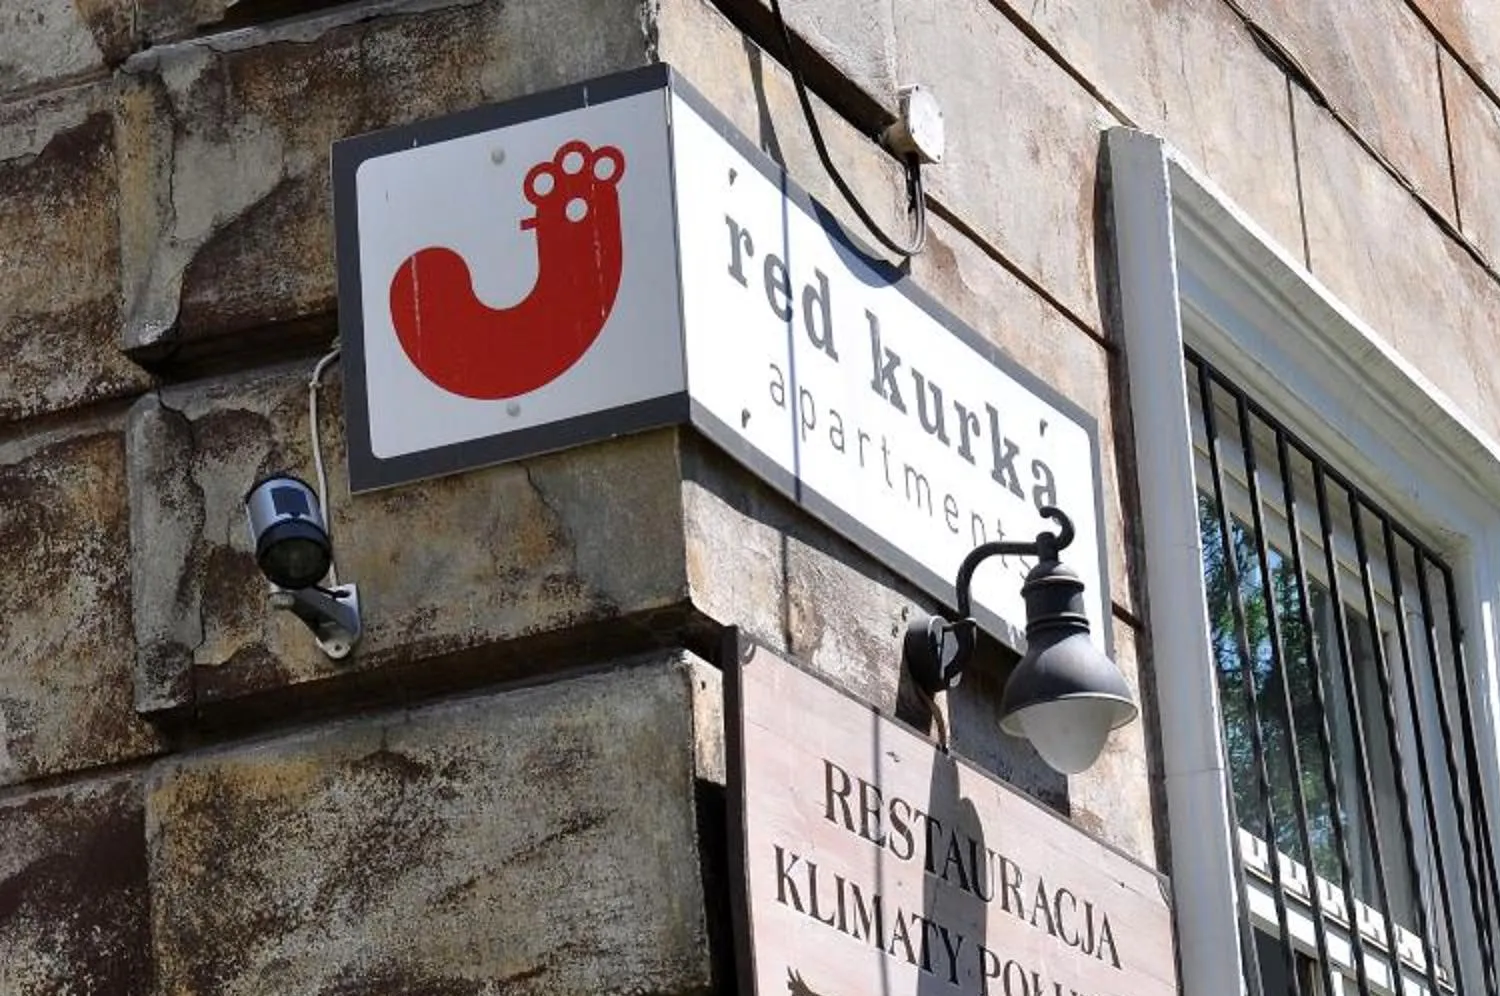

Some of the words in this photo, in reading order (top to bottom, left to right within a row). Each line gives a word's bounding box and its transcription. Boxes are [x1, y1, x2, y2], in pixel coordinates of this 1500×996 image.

[724, 213, 840, 364] red
[864, 307, 1065, 527] kurka
[773, 843, 968, 988] KLIMATY
[822, 757, 1123, 972] RESTAURACJA
